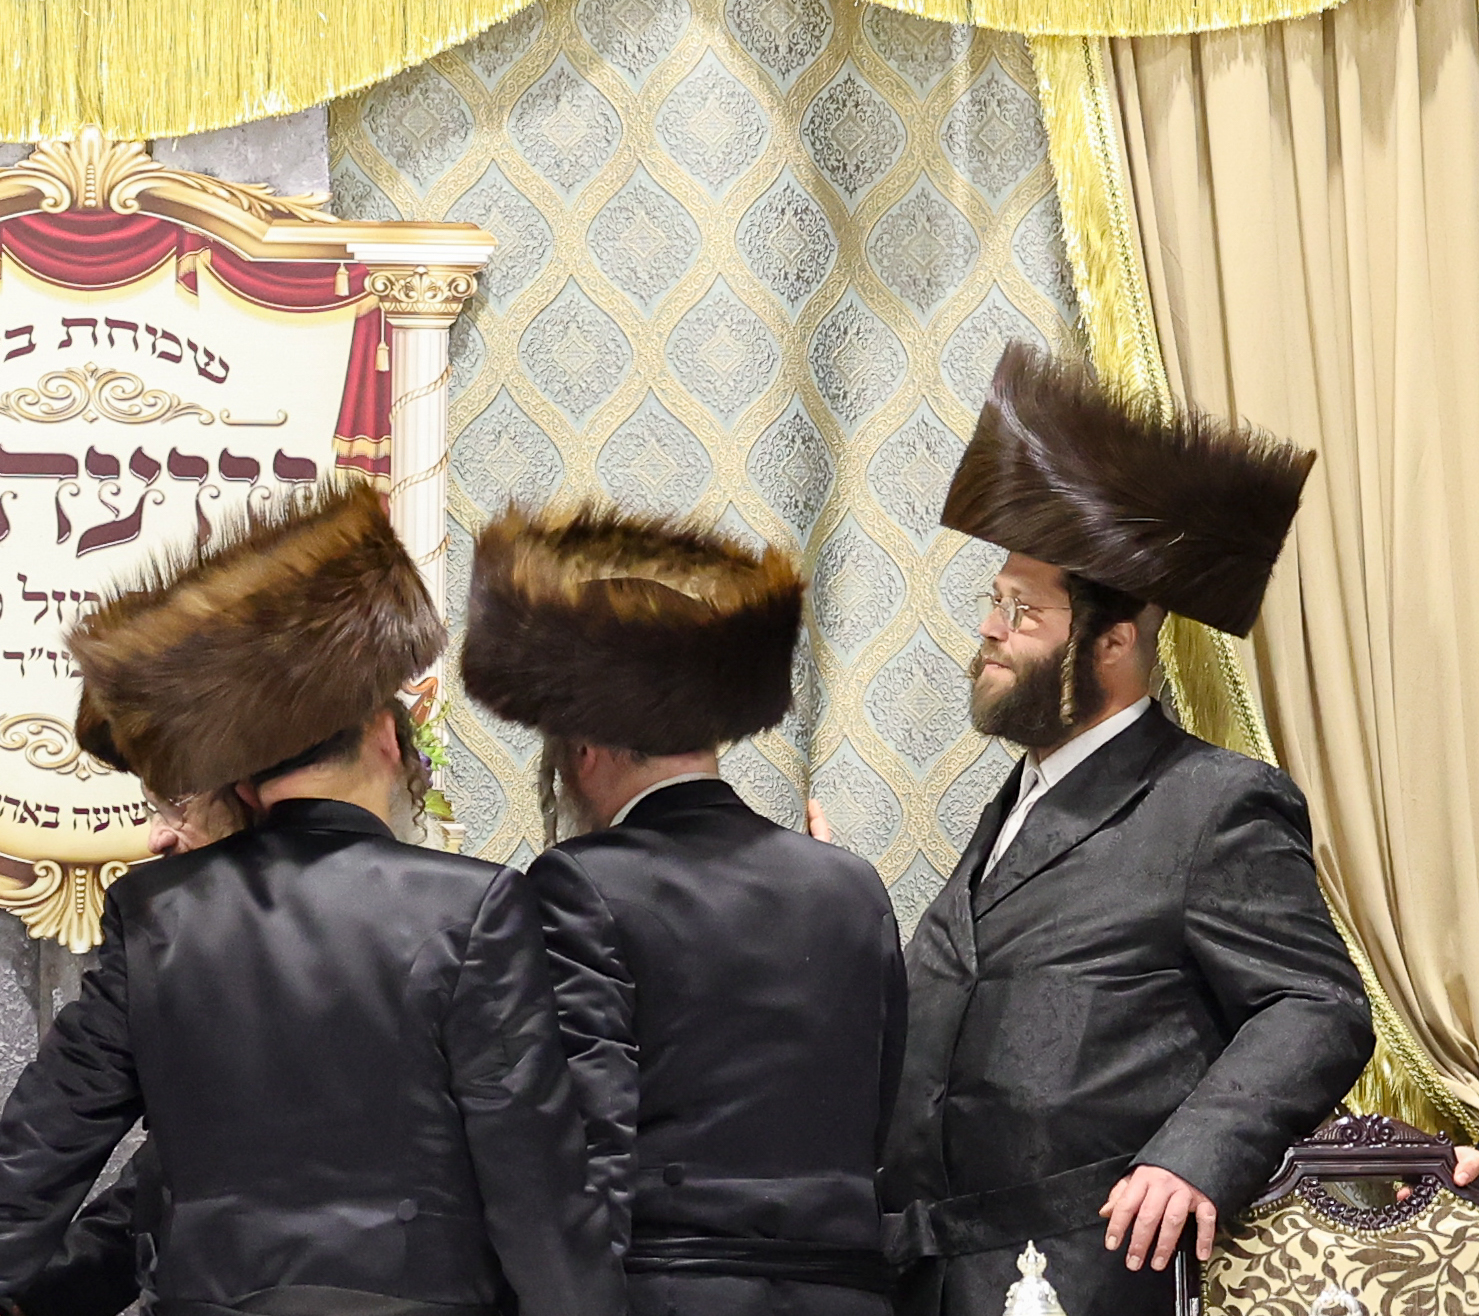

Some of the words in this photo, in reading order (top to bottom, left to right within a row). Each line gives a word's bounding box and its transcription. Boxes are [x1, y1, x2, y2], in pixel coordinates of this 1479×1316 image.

[58, 316, 230, 383] שמחת
[17, 572, 101, 625] מזל
[72, 800, 150, 833] שועה
